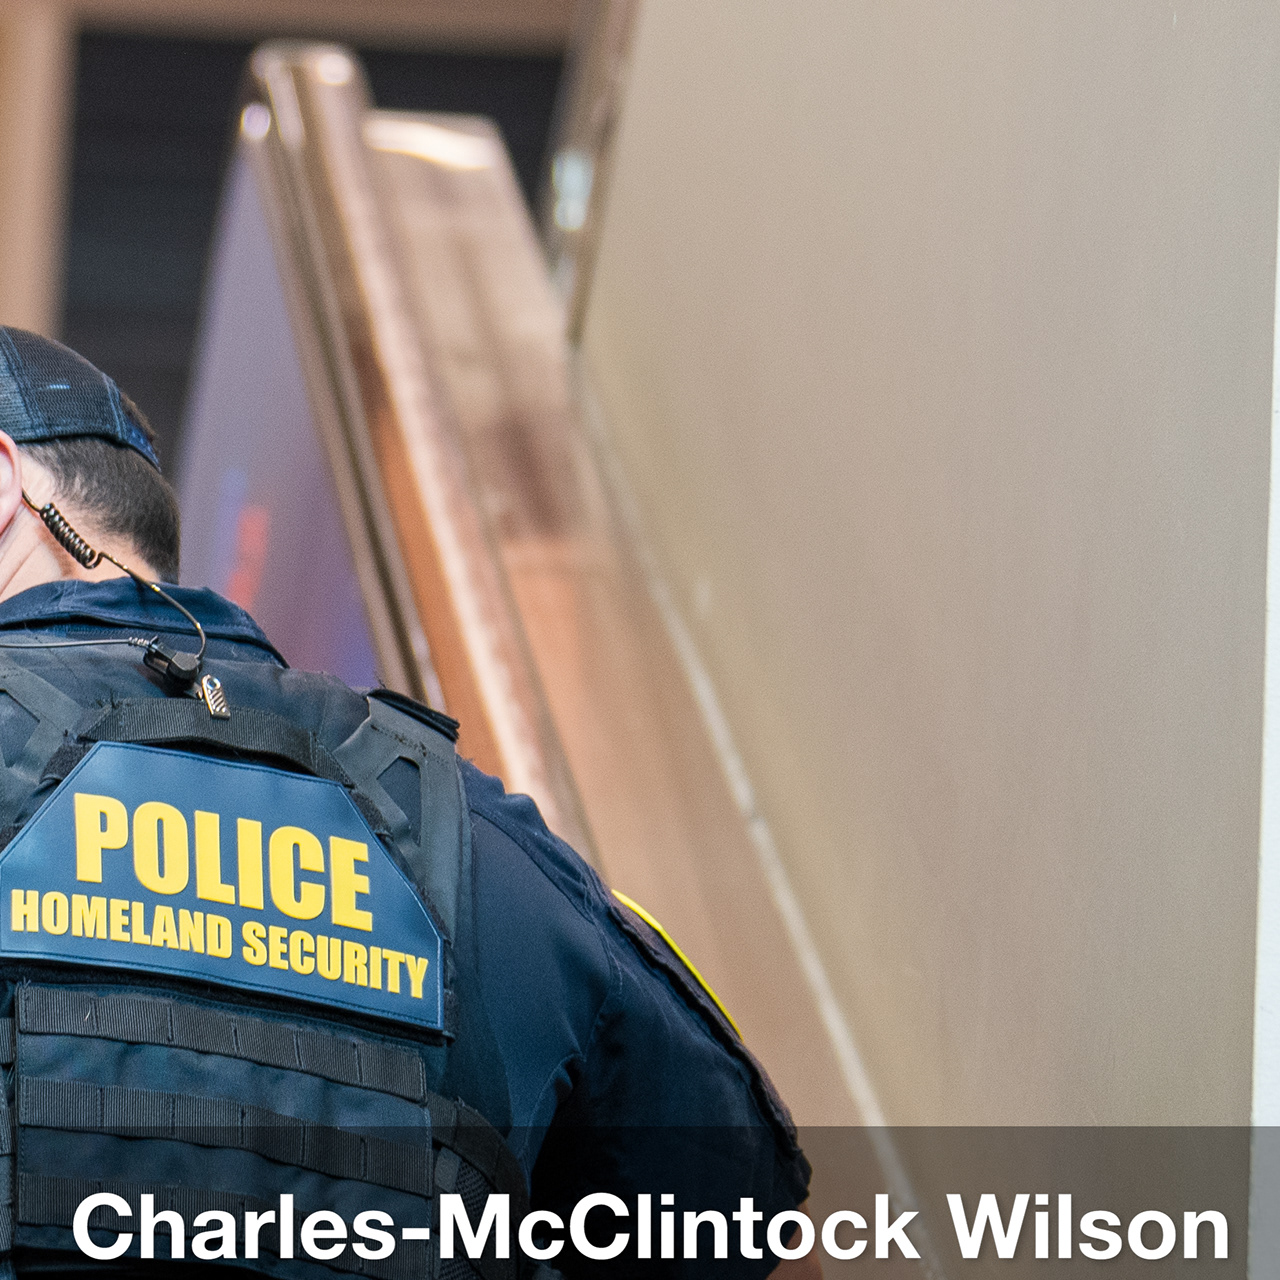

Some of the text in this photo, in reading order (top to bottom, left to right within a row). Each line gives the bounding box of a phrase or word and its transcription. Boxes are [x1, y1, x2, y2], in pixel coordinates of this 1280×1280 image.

[73, 792, 373, 932] POLICE
[10, 889, 429, 999] HOMELAND SECURITY
